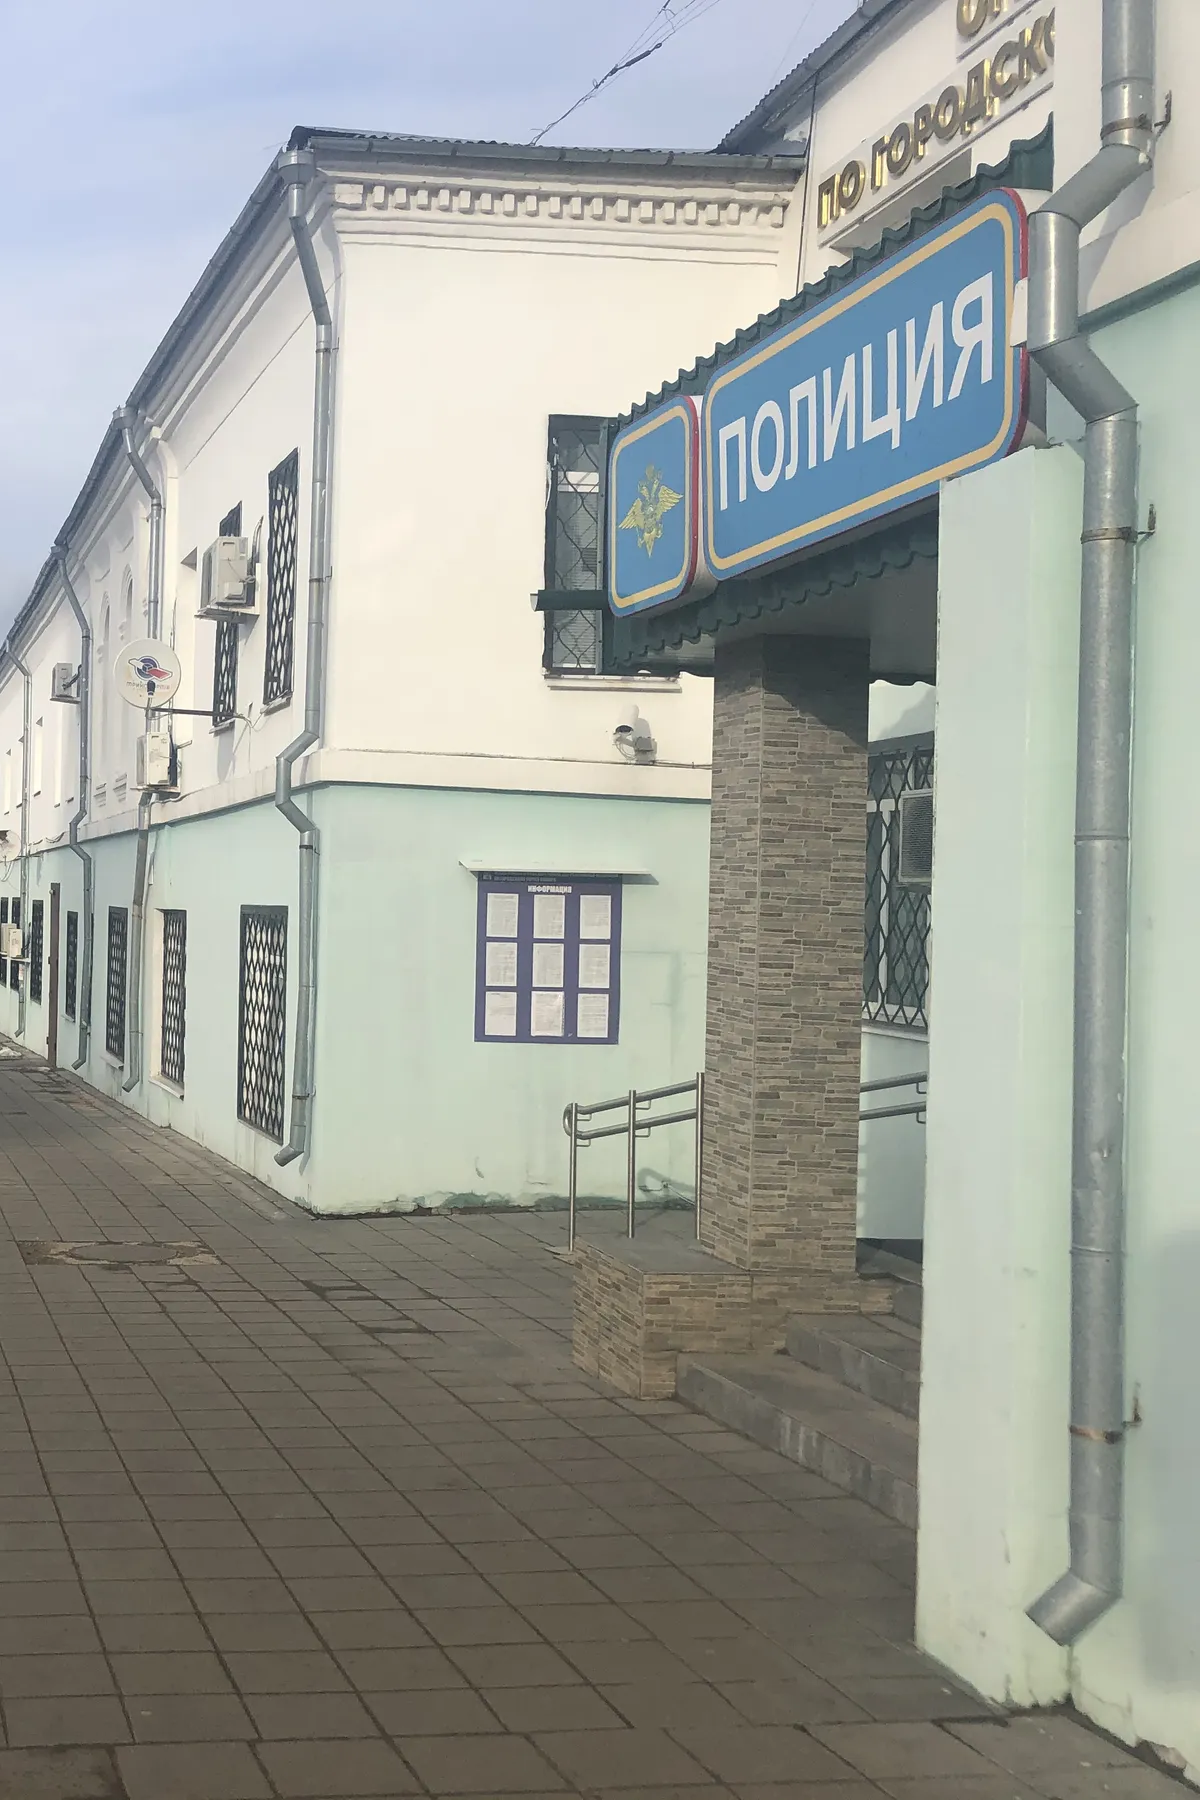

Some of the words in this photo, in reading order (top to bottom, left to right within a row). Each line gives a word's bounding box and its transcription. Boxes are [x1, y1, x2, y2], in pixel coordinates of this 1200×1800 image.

[817, 160, 866, 229] ПО
[718, 271, 993, 511] ПОЛИЦИЯ
[527, 885, 572, 894] ИНФОРМАЦИЯ
